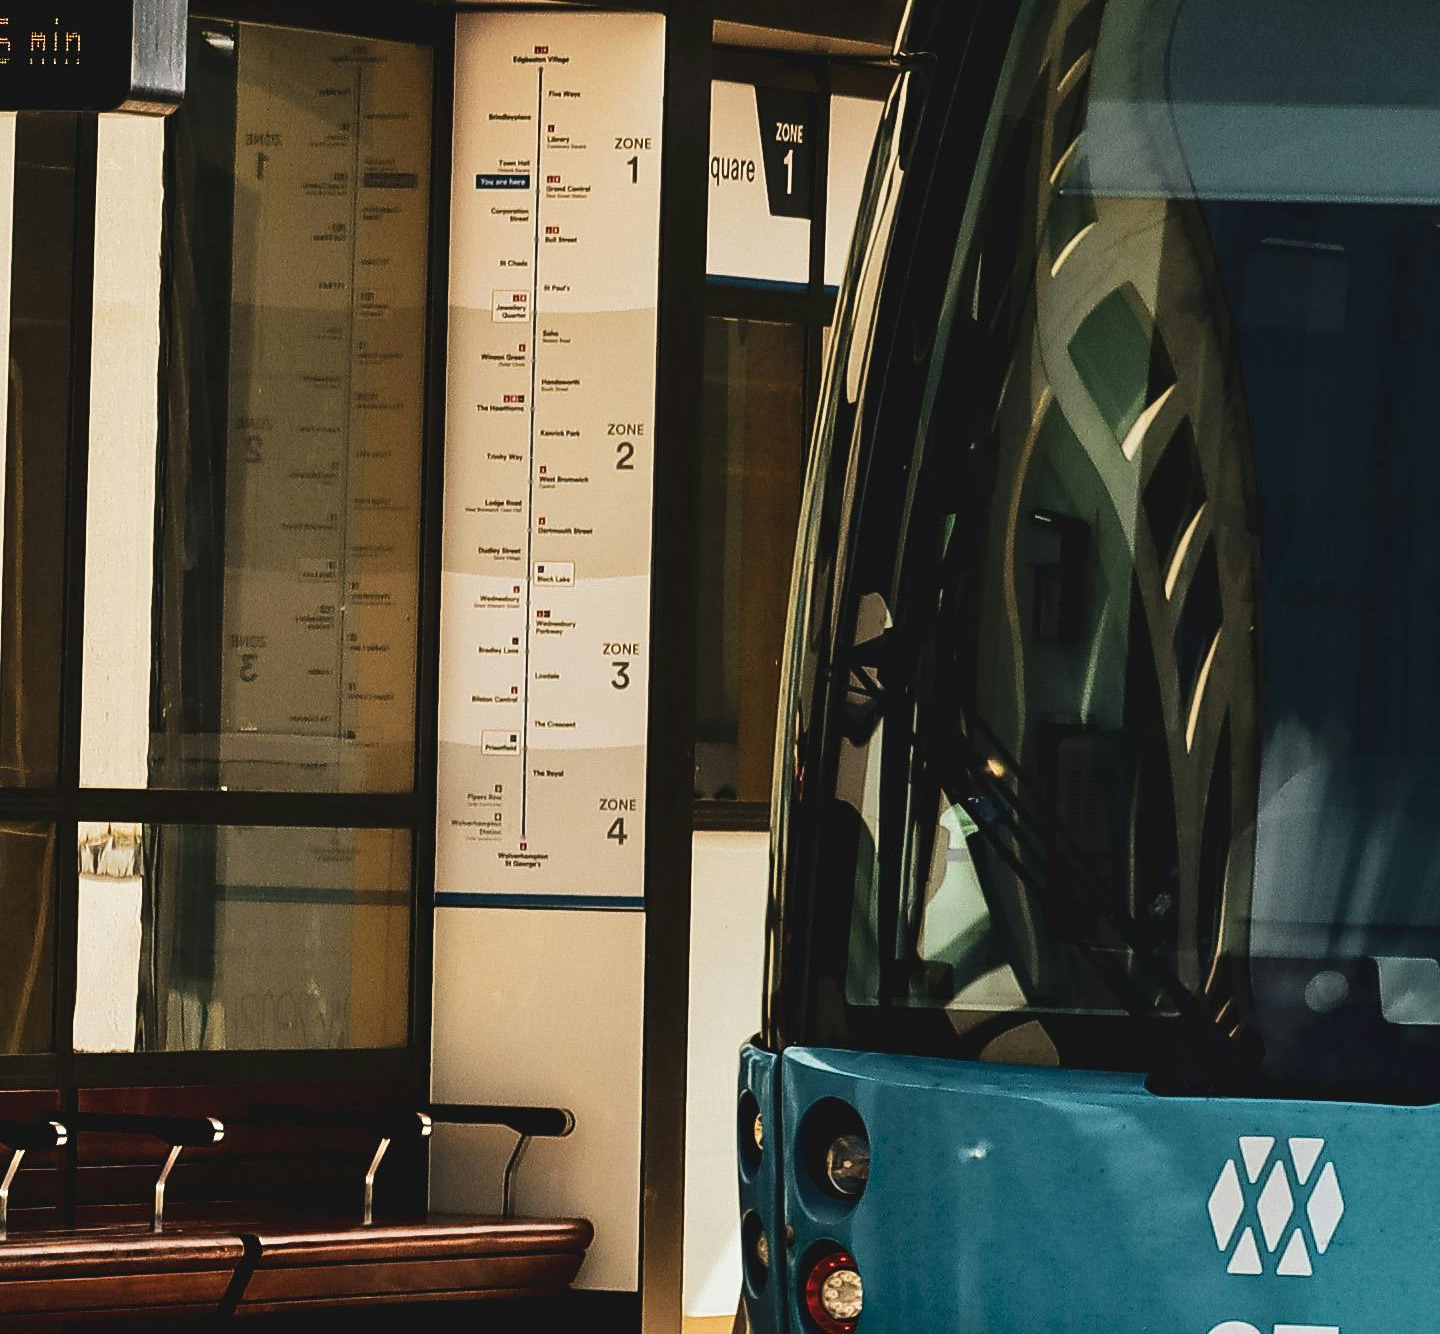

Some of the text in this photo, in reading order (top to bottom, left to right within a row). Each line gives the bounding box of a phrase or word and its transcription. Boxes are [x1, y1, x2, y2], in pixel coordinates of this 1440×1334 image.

[29, 17, 81, 65] min
[547, 136, 570, 144] Library
[776, 122, 803, 143] ZONE
[614, 138, 652, 150] ZONE
[627, 155, 640, 184] 1
[710, 155, 755, 186] quare
[783, 149, 794, 195] 1
[480, 177, 526, 186] You are here
[477, 404, 489, 412] The
[607, 423, 645, 436] ZONE
[616, 441, 635, 470] 2
[602, 643, 640, 655] ZONE
[611, 661, 631, 690] 3
[533, 769, 546, 777] The
[599, 798, 637, 811] ZONE
[606, 817, 628, 845] 4
